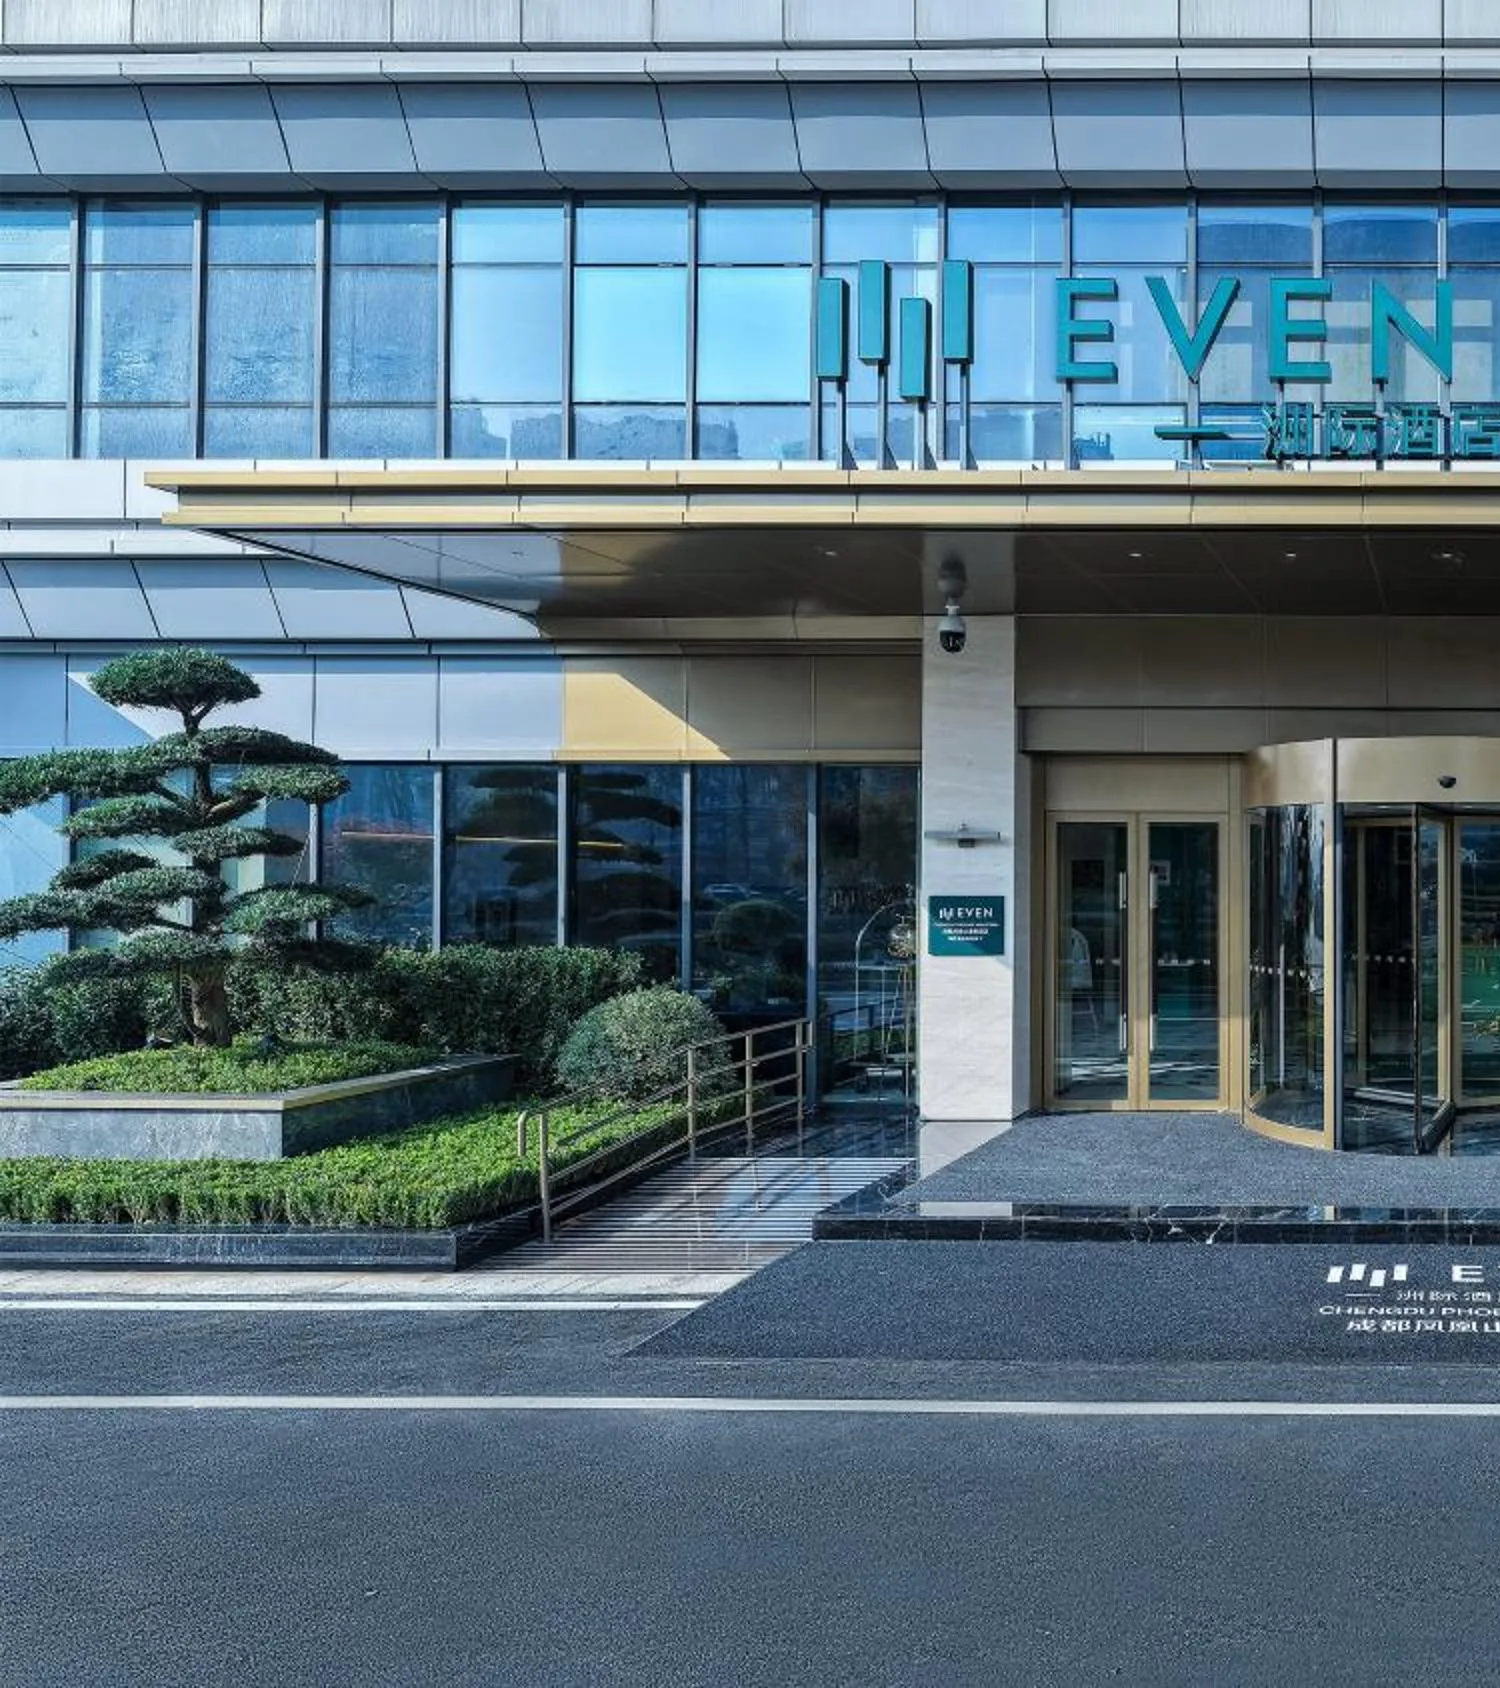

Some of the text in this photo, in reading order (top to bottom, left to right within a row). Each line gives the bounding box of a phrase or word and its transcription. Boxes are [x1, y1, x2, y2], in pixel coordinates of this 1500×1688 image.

[1056, 276, 1453, 385] EVEN
[957, 907, 993, 919] EVEN
[1319, 1305, 1435, 1316] CHENGDU
